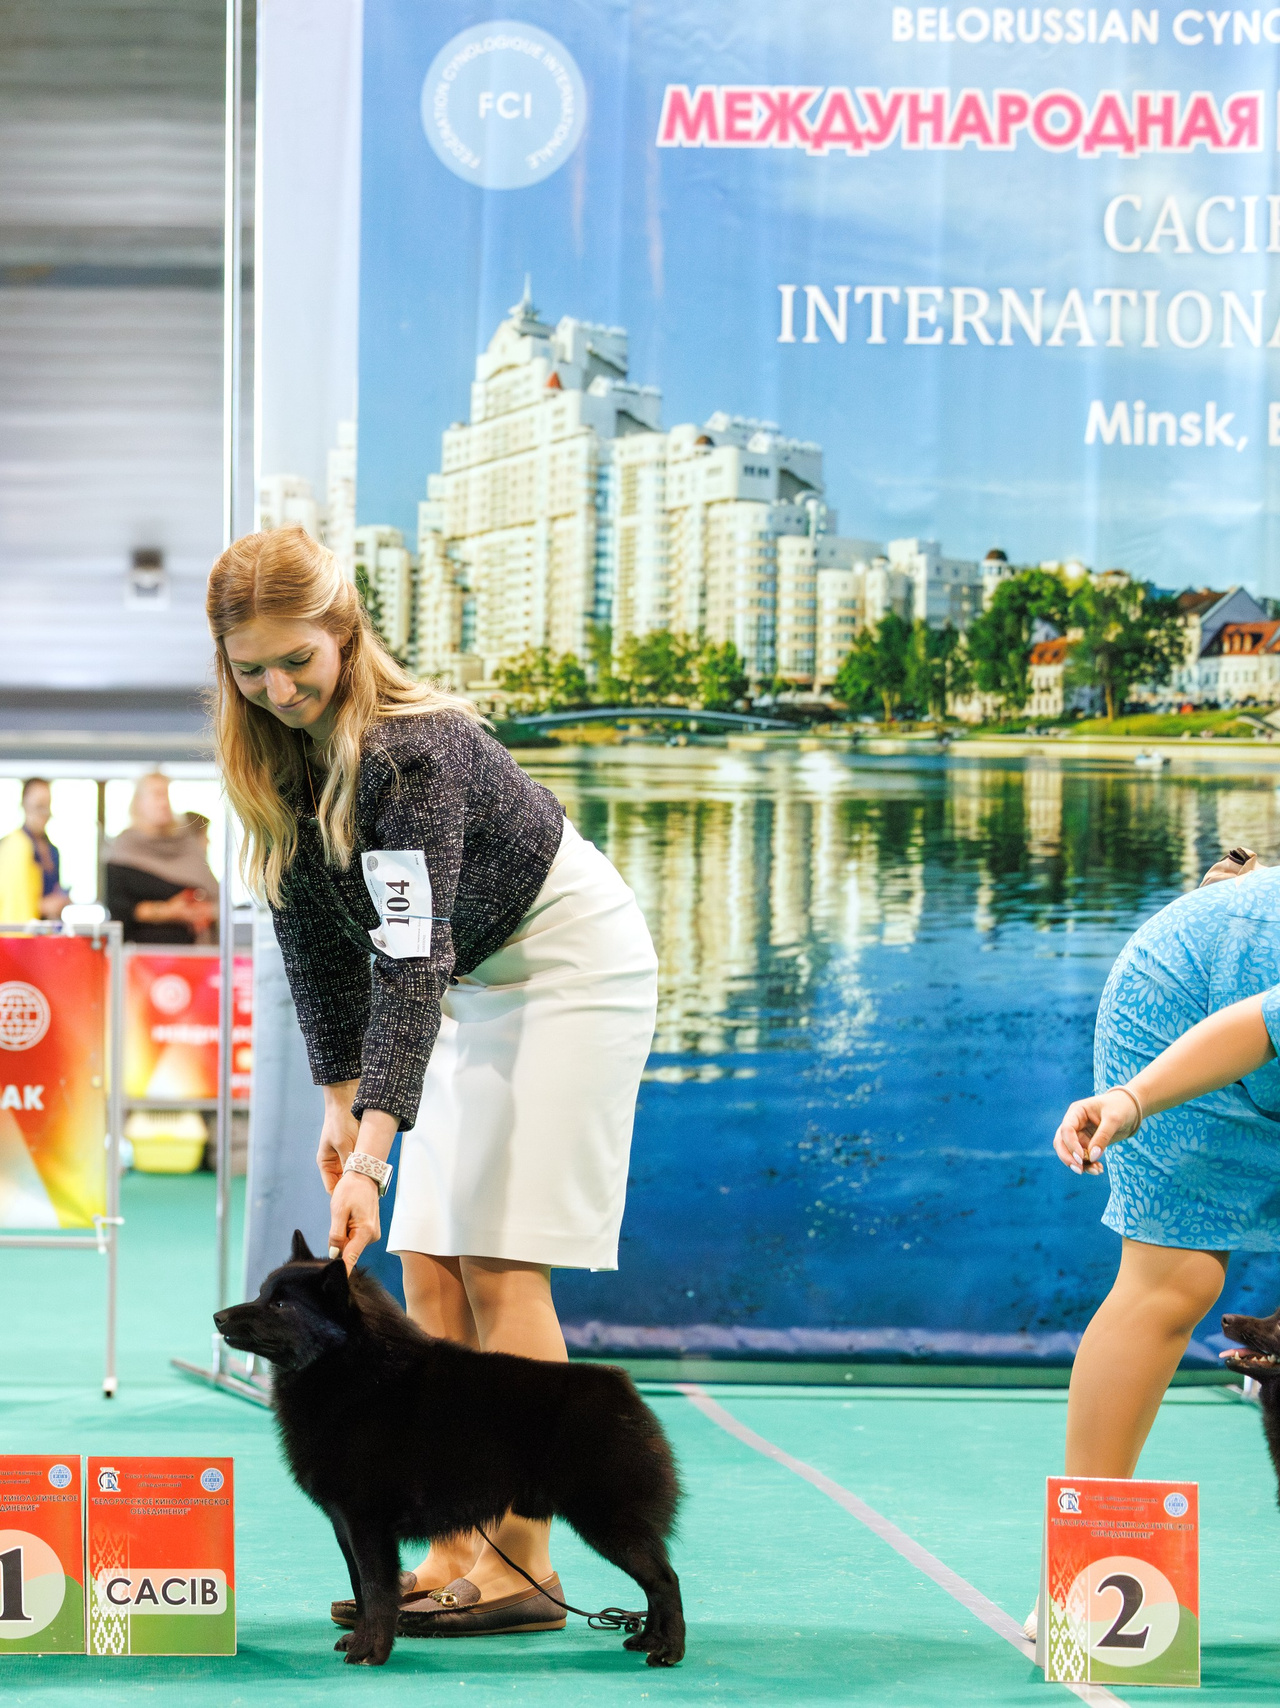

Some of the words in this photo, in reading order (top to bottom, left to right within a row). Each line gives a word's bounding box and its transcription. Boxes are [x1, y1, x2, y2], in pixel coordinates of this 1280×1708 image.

[891, 6, 1159, 45] BELORUSSIAN
[478, 91, 532, 120] FCI
[658, 86, 1263, 157] МЕЖДУНАРОДНАЯ
[1084, 399, 1248, 453] Minsk,
[385, 879, 410, 927] 104
[155, 1498, 230, 1506] КИНОЛОГИЧЕСКОЕ
[105, 1576, 219, 1606] CACIB
[1094, 1571, 1153, 1650] 2
